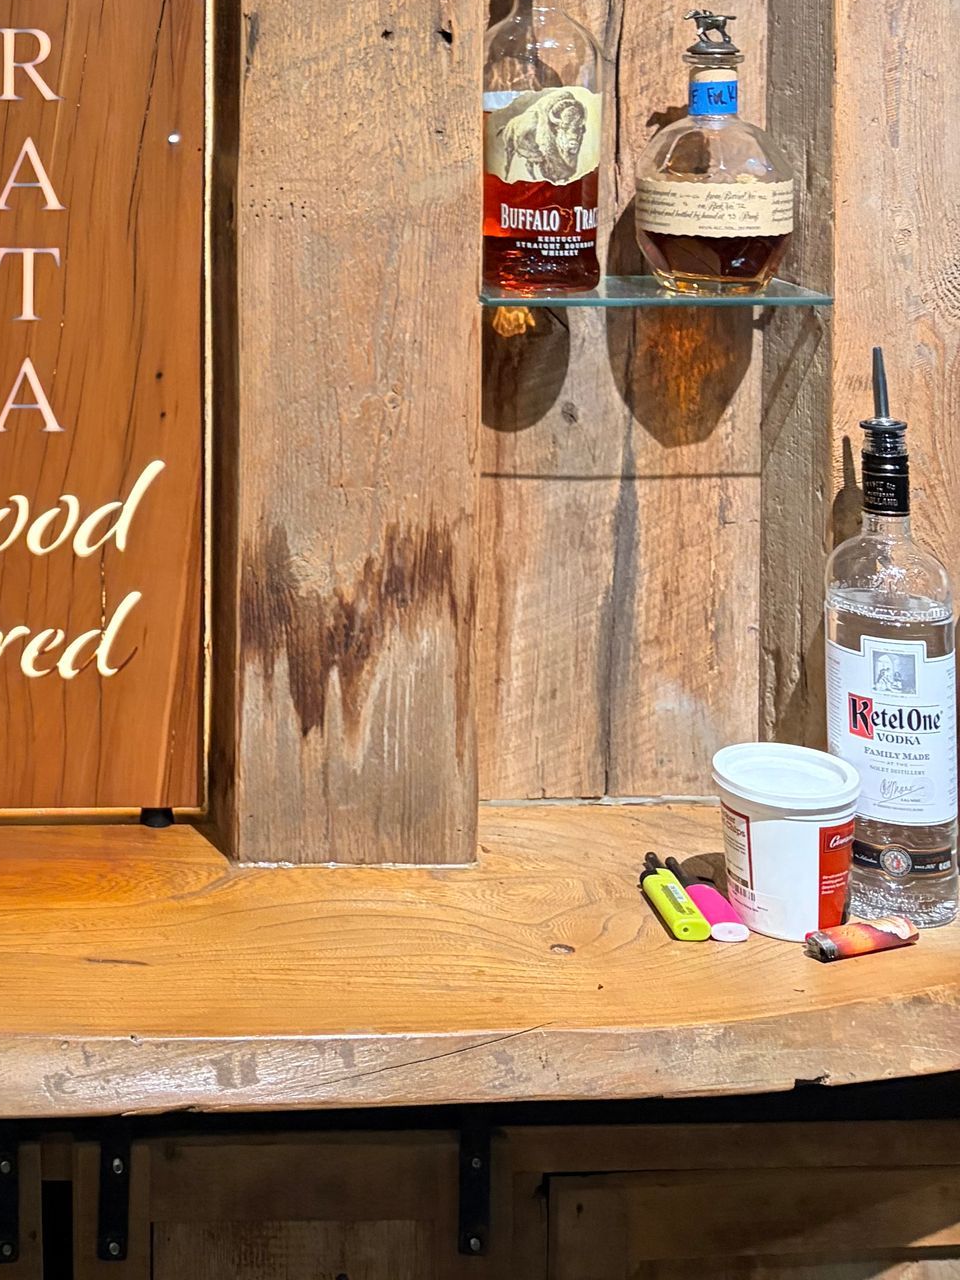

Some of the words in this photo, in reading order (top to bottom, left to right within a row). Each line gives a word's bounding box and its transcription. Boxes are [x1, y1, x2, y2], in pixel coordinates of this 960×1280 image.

[500, 202, 560, 232] BUFFALO
[573, 206, 598, 232] TRAC
[516, 241, 560, 249] STRAIGHT
[851, 697, 904, 736] Ketel
[907, 708, 941, 731] One
[876, 732, 921, 745] VODKA
[864, 746, 901, 760] FAMILY
[902, 752, 930, 760] MADE
[890, 768, 925, 776] DISTILLERY
